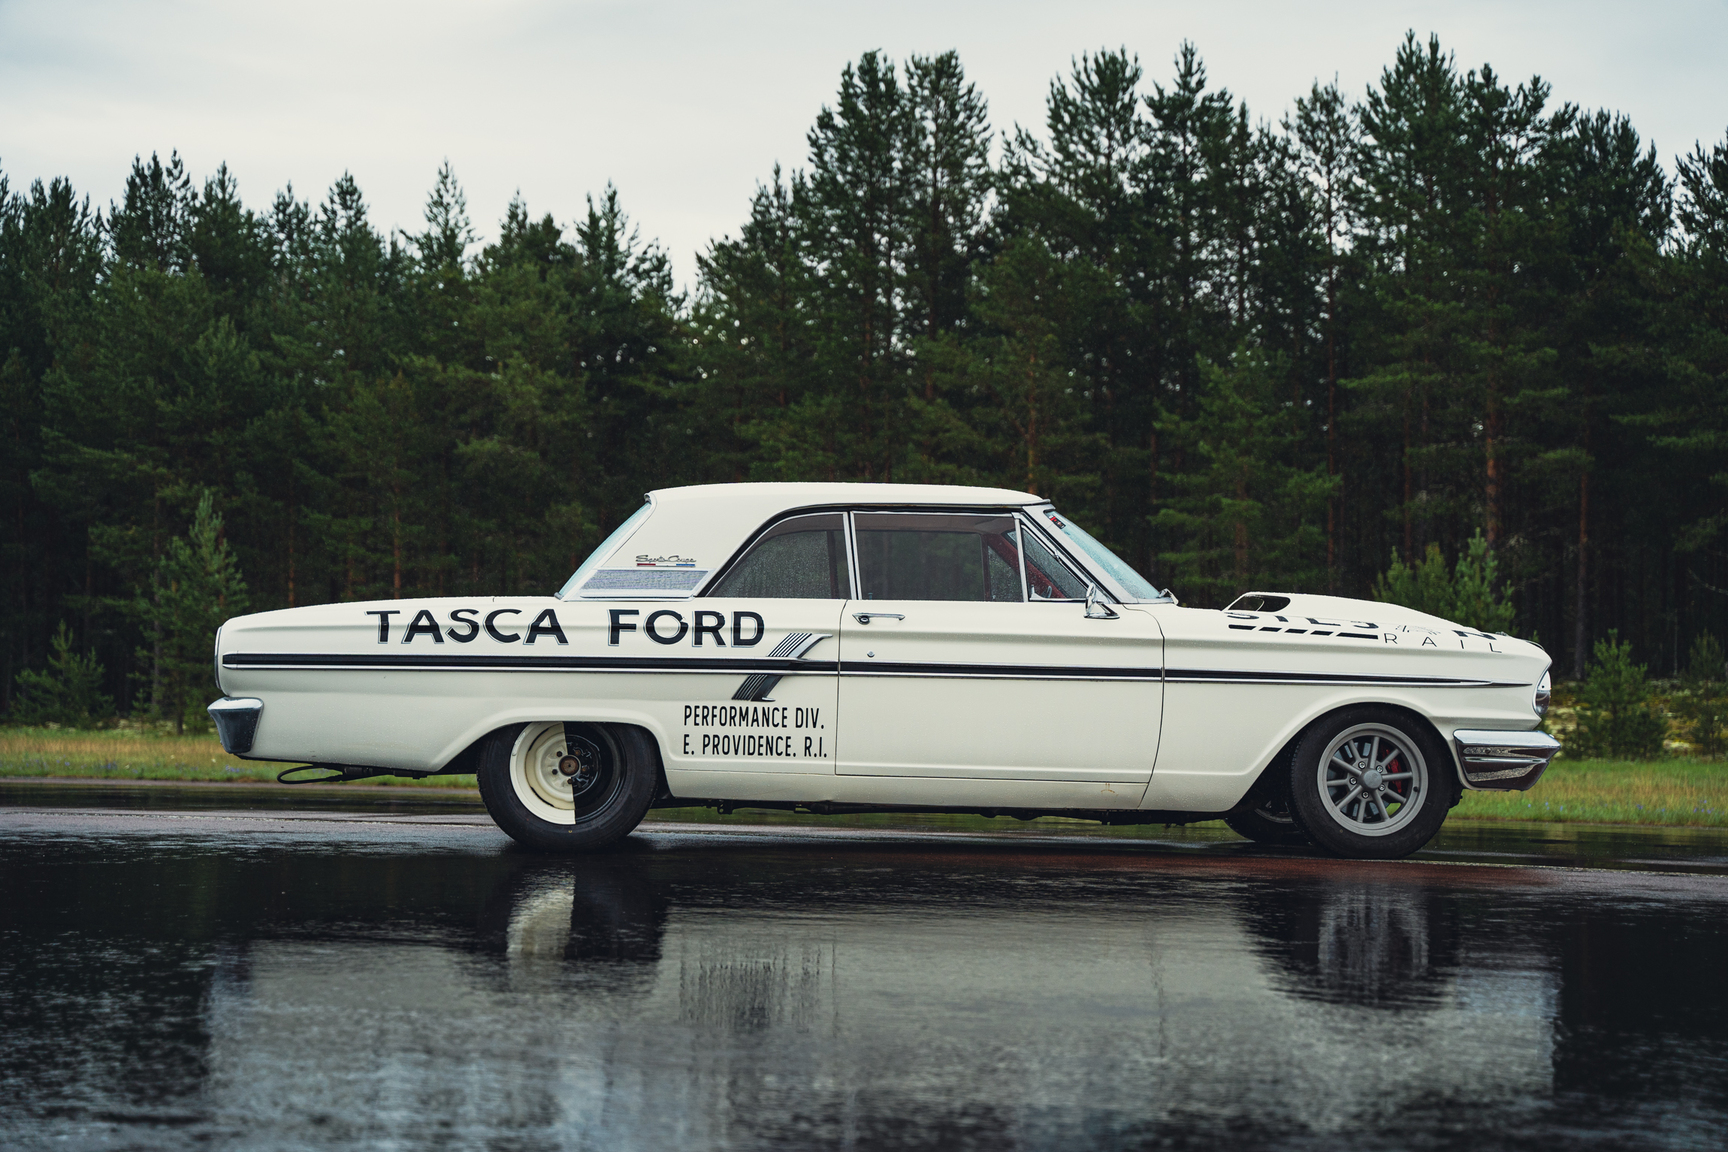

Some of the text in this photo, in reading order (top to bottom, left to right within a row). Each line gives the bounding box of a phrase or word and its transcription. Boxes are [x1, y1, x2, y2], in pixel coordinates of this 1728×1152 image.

[366, 608, 765, 647] TASCA FORD
[684, 705, 825, 729] PERFORMANCE DIV.
[683, 734, 695, 755] E.
[804, 736, 828, 758] R.I.
